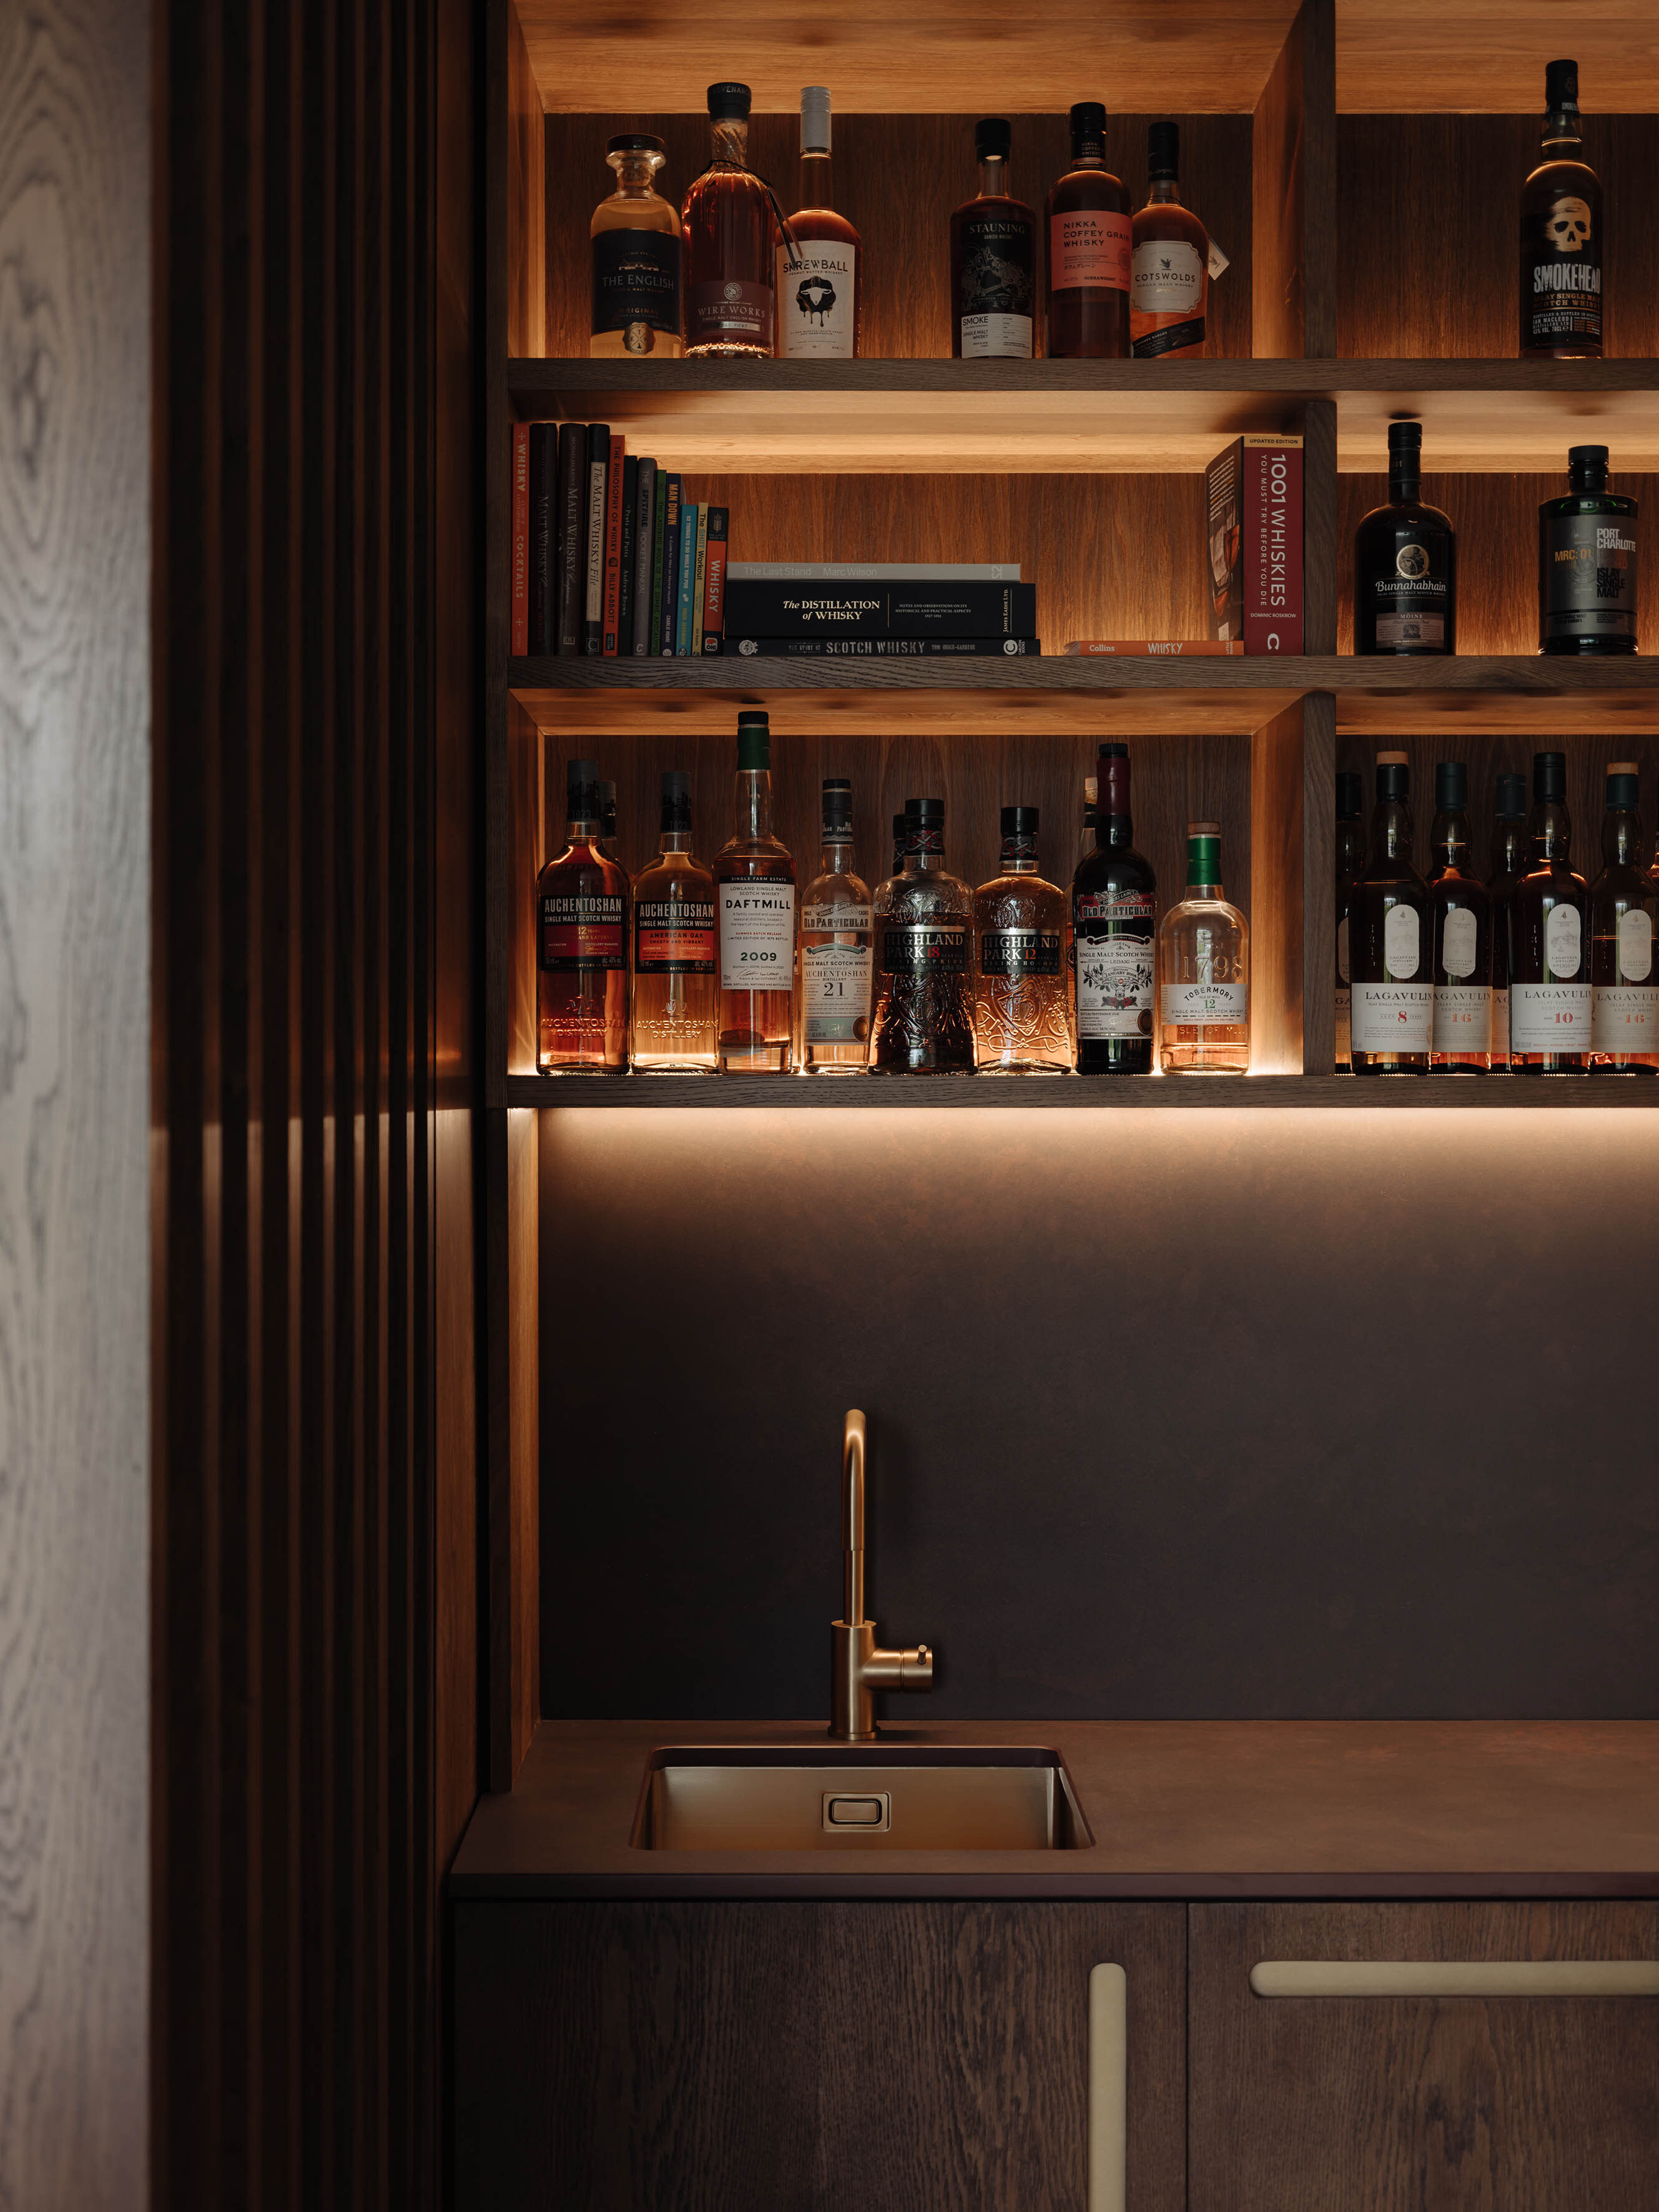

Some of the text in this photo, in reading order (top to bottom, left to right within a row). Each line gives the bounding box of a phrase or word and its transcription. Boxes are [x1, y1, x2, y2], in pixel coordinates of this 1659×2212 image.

[969, 223, 1025, 234] STAUNING
[1064, 221, 1096, 229] NIKKA
[1106, 232, 1129, 240] GRAIN
[1064, 239, 1105, 247] WHISKY
[783, 260, 848, 273] SKREWBALL
[602, 275, 623, 287] THE
[628, 274, 674, 290] ENGLISH
[1135, 273, 1195, 282] COTSWOLDS
[1533, 263, 1600, 294] SMOKEHEAD
[697, 305, 765, 318] WIRE WORKS
[963, 316, 988, 326] SMOKE
[517, 444, 526, 492] WHISKY
[593, 468, 603, 481] The
[612, 463, 620, 509] PHILOSOPHY
[593, 486, 602, 516] MALT
[667, 484, 678, 524] MAN DOWN
[539, 494, 549, 528] MALT
[641, 489, 649, 528] SPITFIRE
[611, 512, 618, 523] OF
[567, 487, 578, 571] MALT WHISKY
[1271, 454, 1287, 606] 1001 WHISKIES
[1597, 528, 1620, 539] PORT
[591, 519, 601, 565] WHISKY
[639, 531, 648, 561] POCKET
[1597, 538, 1636, 553] CHARLOTTE
[538, 529, 549, 575] WHISKY
[1555, 549, 1592, 562] MRC: 01
[516, 534, 524, 599] COCKTAILS
[744, 567, 877, 576] The Last Stand Marc Wilson
[1597, 567, 1621, 578] ISLAY
[589, 568, 599, 586] File
[638, 563, 646, 595] MANUAL
[1597, 578, 1626, 589] SINGLE
[709, 559, 721, 613] WHISKY
[1375, 579, 1447, 592] Bunnahabhain
[1597, 587, 1619, 598] MALT
[783, 600, 880, 610] The DISTILLATION
[802, 611, 862, 621] of WHISKY
[826, 641, 925, 654] SCOTCH WHISKY
[1148, 642, 1183, 654] WHISKY
[544, 898, 622, 913] AUCHENTOSHAN
[639, 903, 714, 918] AUCHENTOSHAN
[726, 900, 790, 910] DAFTMILL
[1082, 905, 1153, 917] OLD PARTICULAR
[563, 915, 578, 923] MALT
[817, 918, 869, 928] PARTICULAR
[578, 927, 587, 935] 12
[887, 933, 963, 946] HIGHLAND
[984, 936, 1058, 948] HIGHLAND
[741, 952, 777, 961] 2009
[887, 946, 940, 960] PARK 18
[983, 948, 1036, 962] PARK 12
[1183, 955, 1243, 980] 1798
[824, 982, 845, 996] 21
[1184, 986, 1234, 1001] TOBERMORY
[1525, 990, 1592, 999] LAGAVULIN
[1366, 991, 1432, 1001] LAGAVULIN
[1204, 1000, 1216, 1009] 12
[1398, 1010, 1407, 1024] 8
[1453, 1013, 1472, 1023] 16
[1555, 1012, 1573, 1024] 10
[1626, 1014, 1645, 1023] 16
[652, 1030, 701, 1039] DISTILLERY
